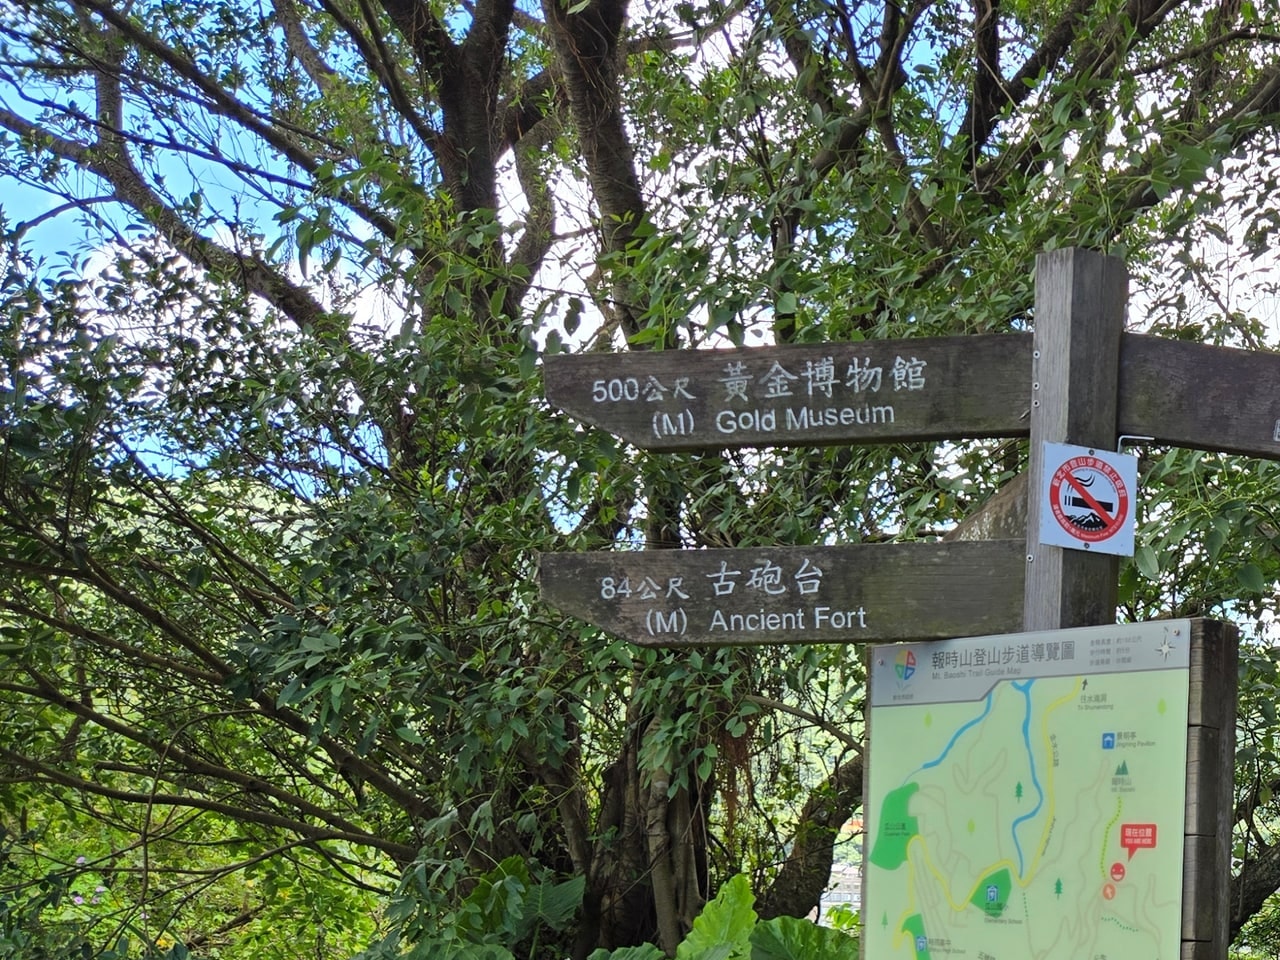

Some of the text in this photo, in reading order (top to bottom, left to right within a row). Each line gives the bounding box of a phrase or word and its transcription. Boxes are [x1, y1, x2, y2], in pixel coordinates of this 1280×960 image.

[592, 355, 929, 403] 500公尺 黃金博物館
[652, 402, 896, 437] (M) Gold Museum
[600, 558, 824, 601] 84公尺 古砲台
[646, 605, 867, 636] (M) Ancient Fort
[931, 640, 1076, 670] 報時山登山步道導覽圖
[1006, 666, 1021, 676] Map
